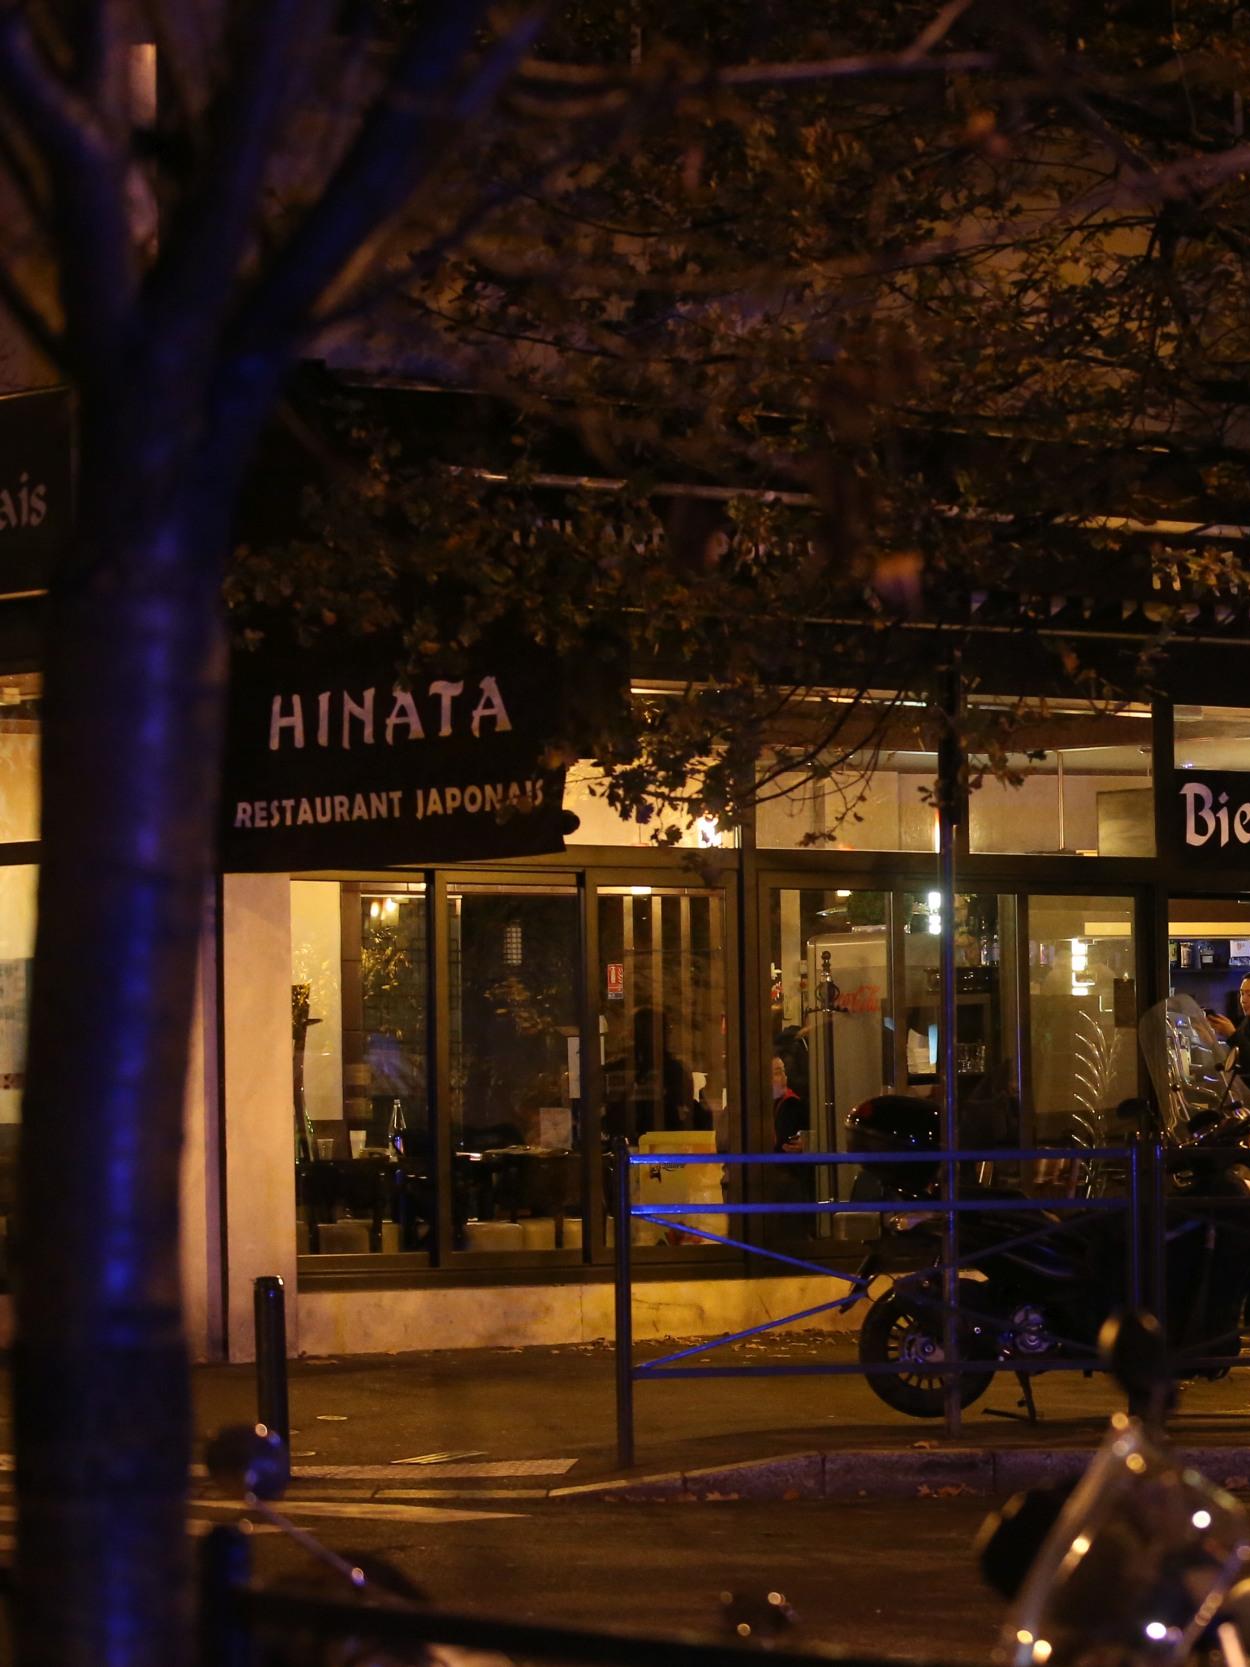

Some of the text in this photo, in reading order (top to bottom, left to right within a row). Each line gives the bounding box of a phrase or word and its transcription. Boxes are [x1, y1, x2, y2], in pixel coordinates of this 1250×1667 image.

[268, 675, 513, 751] HINATA
[233, 778, 545, 829] RESTAURANT JAPONAIS
